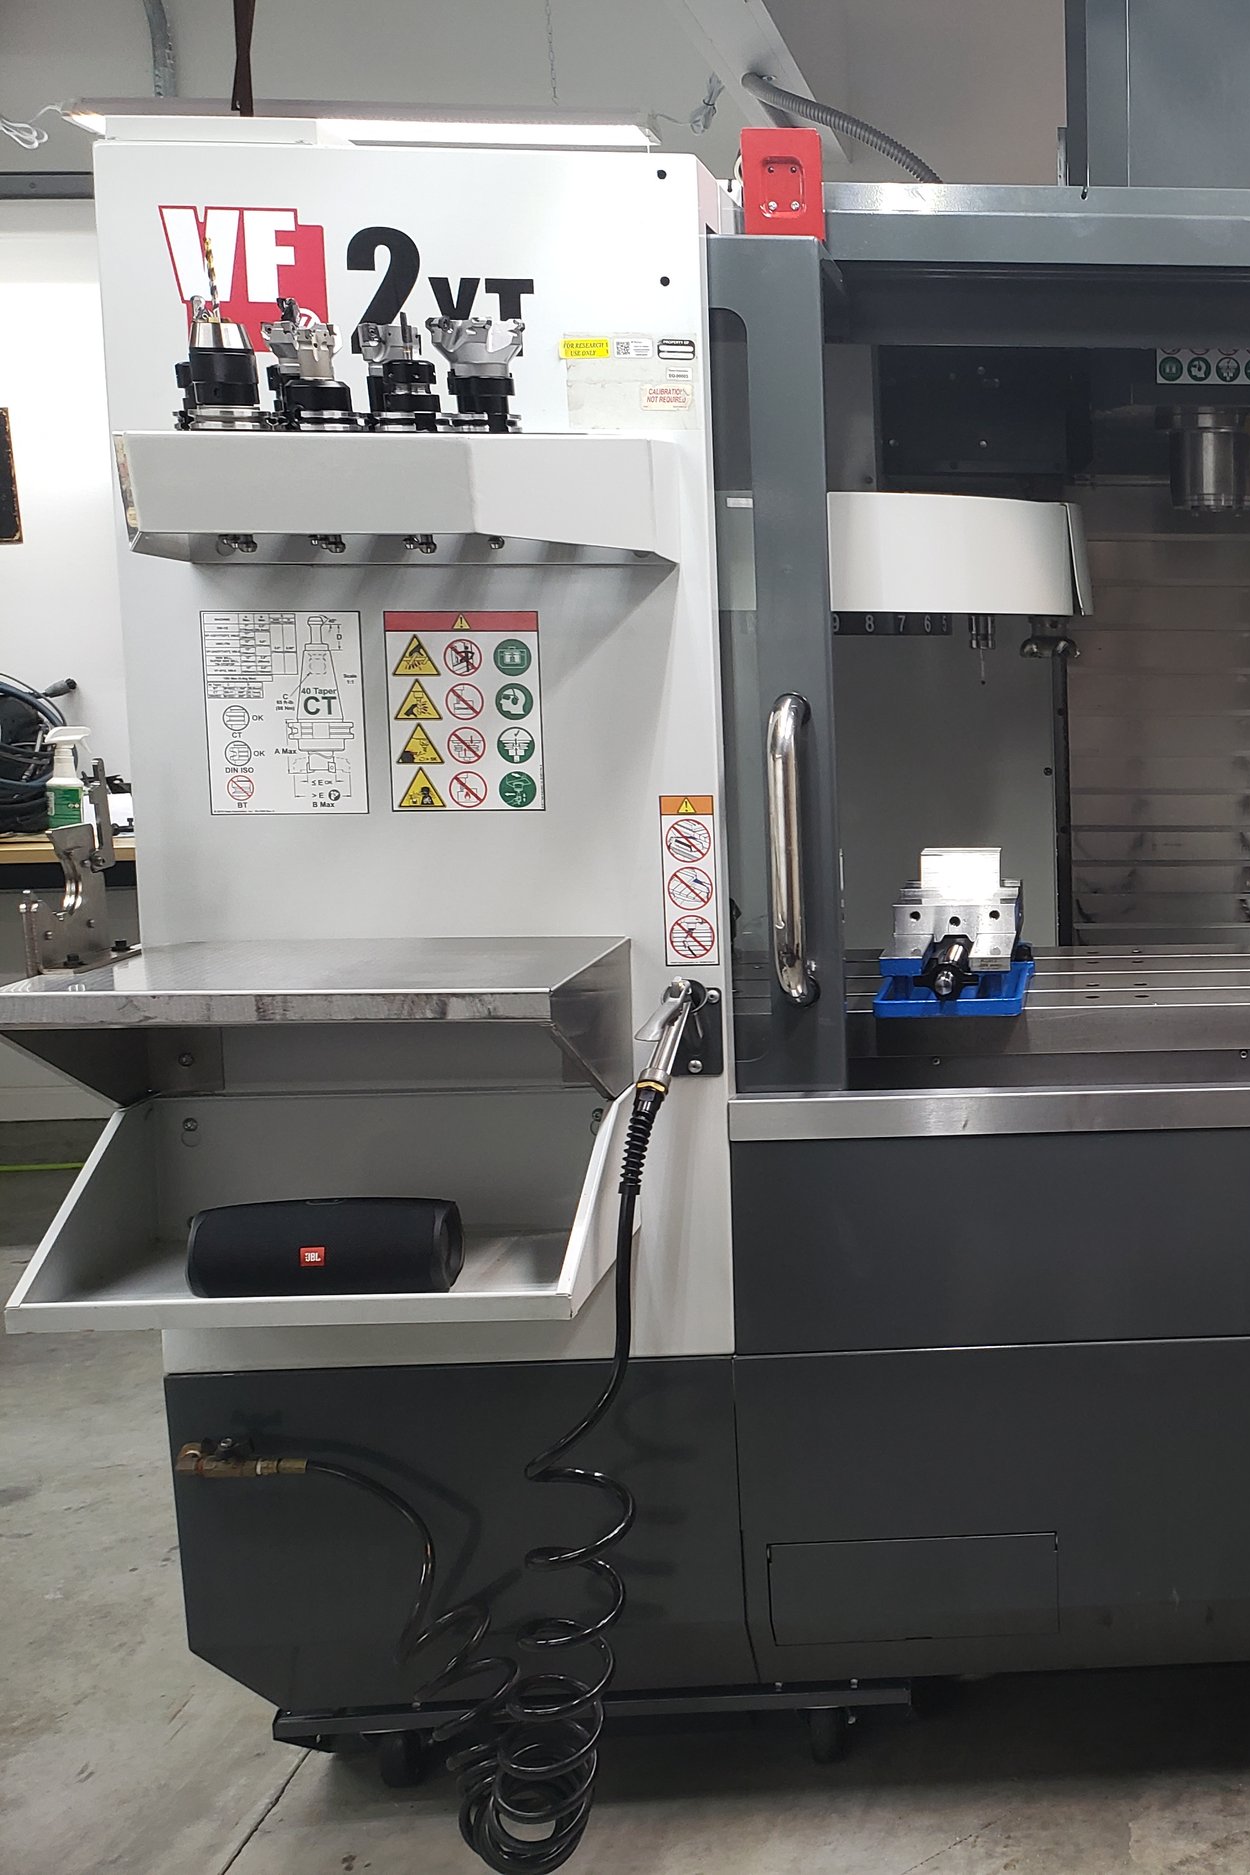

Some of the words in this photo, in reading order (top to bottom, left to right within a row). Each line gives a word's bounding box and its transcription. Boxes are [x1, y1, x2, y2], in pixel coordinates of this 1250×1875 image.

[157, 205, 298, 304] VF
[865, 614, 875, 632] 8
[898, 615, 906, 632] 7
[924, 614, 932, 633] 6
[942, 615, 947, 632] 5
[303, 696, 337, 715] CT
[304, 1252, 321, 1262] JBL
